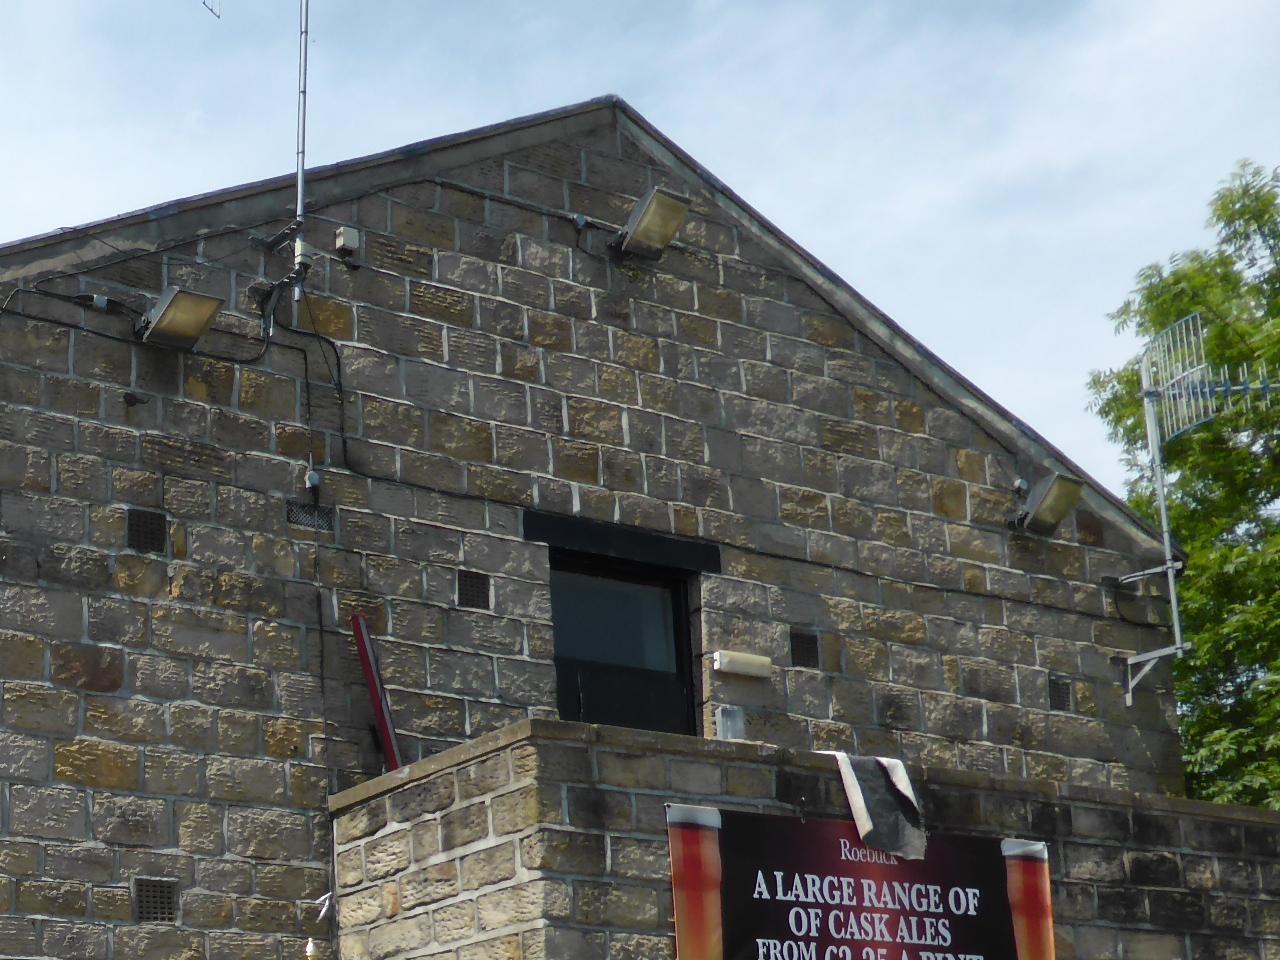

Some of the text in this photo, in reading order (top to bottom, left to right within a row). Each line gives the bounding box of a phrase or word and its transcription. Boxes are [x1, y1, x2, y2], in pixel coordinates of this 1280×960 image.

[753, 870, 981, 916] A LARGE RANGE OF
[789, 906, 952, 947] OF CASK ALES
